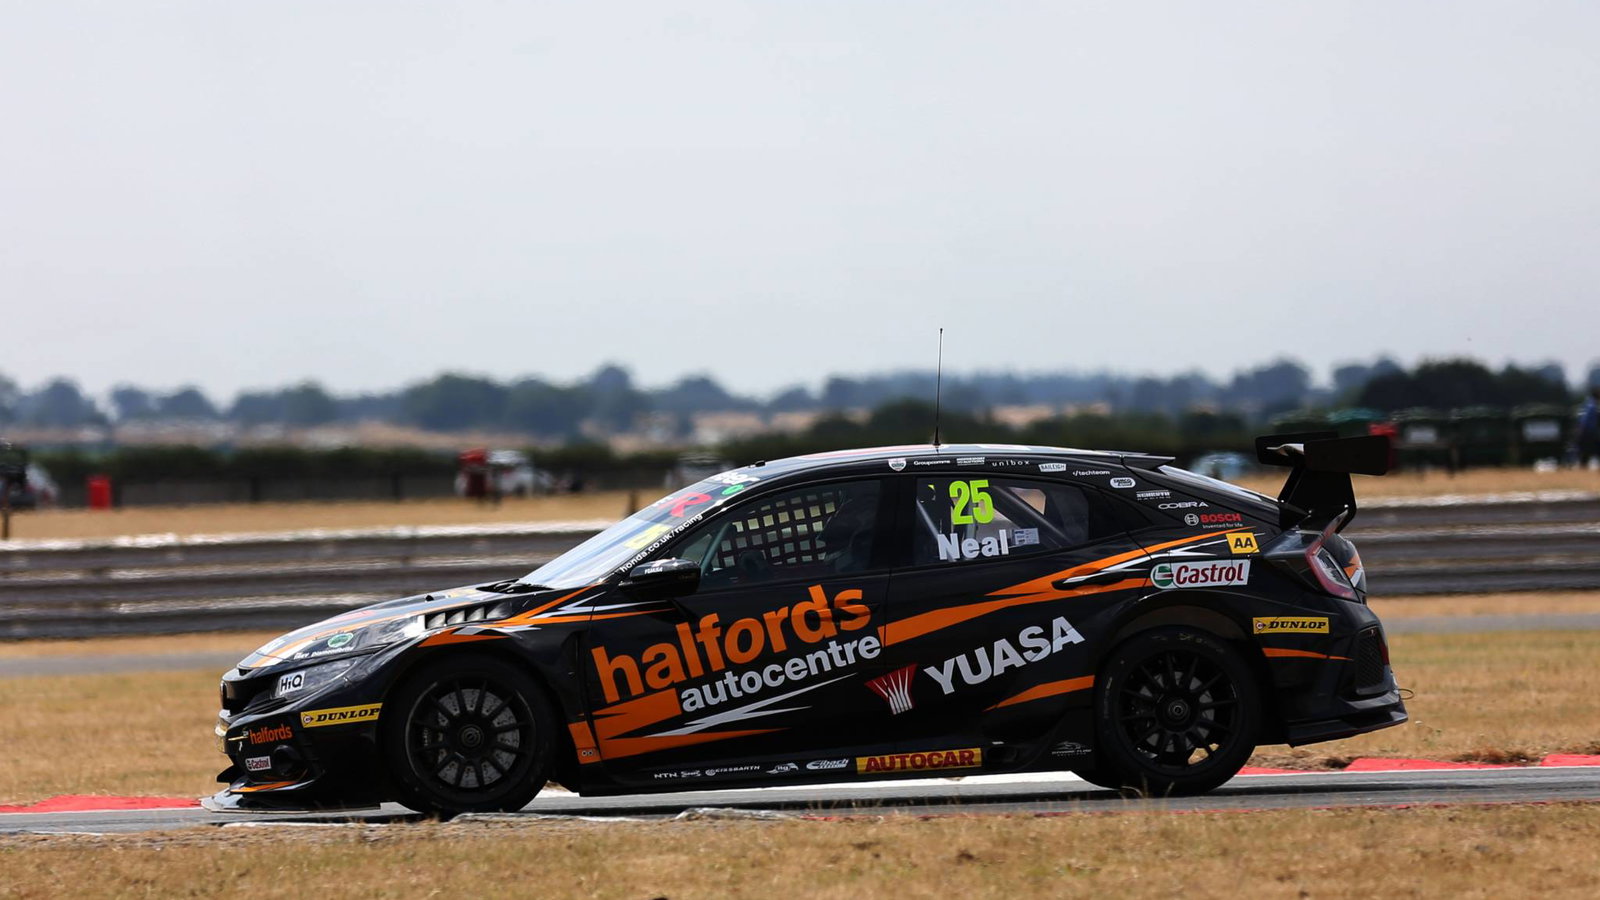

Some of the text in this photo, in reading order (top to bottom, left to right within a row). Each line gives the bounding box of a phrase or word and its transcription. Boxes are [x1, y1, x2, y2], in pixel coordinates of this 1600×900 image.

[949, 479, 994, 525] 25
[1158, 501, 1209, 510] COBRA
[1200, 513, 1242, 523] BOSCH
[620, 513, 703, 573] honda.co.uk/racing
[937, 529, 1009, 561] Neal
[1233, 537, 1254, 549] AA
[1175, 562, 1244, 585] Castrol
[1268, 620, 1327, 630] DUNLOP
[591, 584, 872, 704] halfords
[923, 616, 1086, 695] YUASA
[280, 674, 303, 692] HiQ
[681, 635, 881, 713] autocentre
[316, 707, 381, 722] DUNLOP
[250, 724, 293, 745] halfords
[251, 757, 270, 769] Castrol
[865, 749, 975, 772] AUTOCAR
